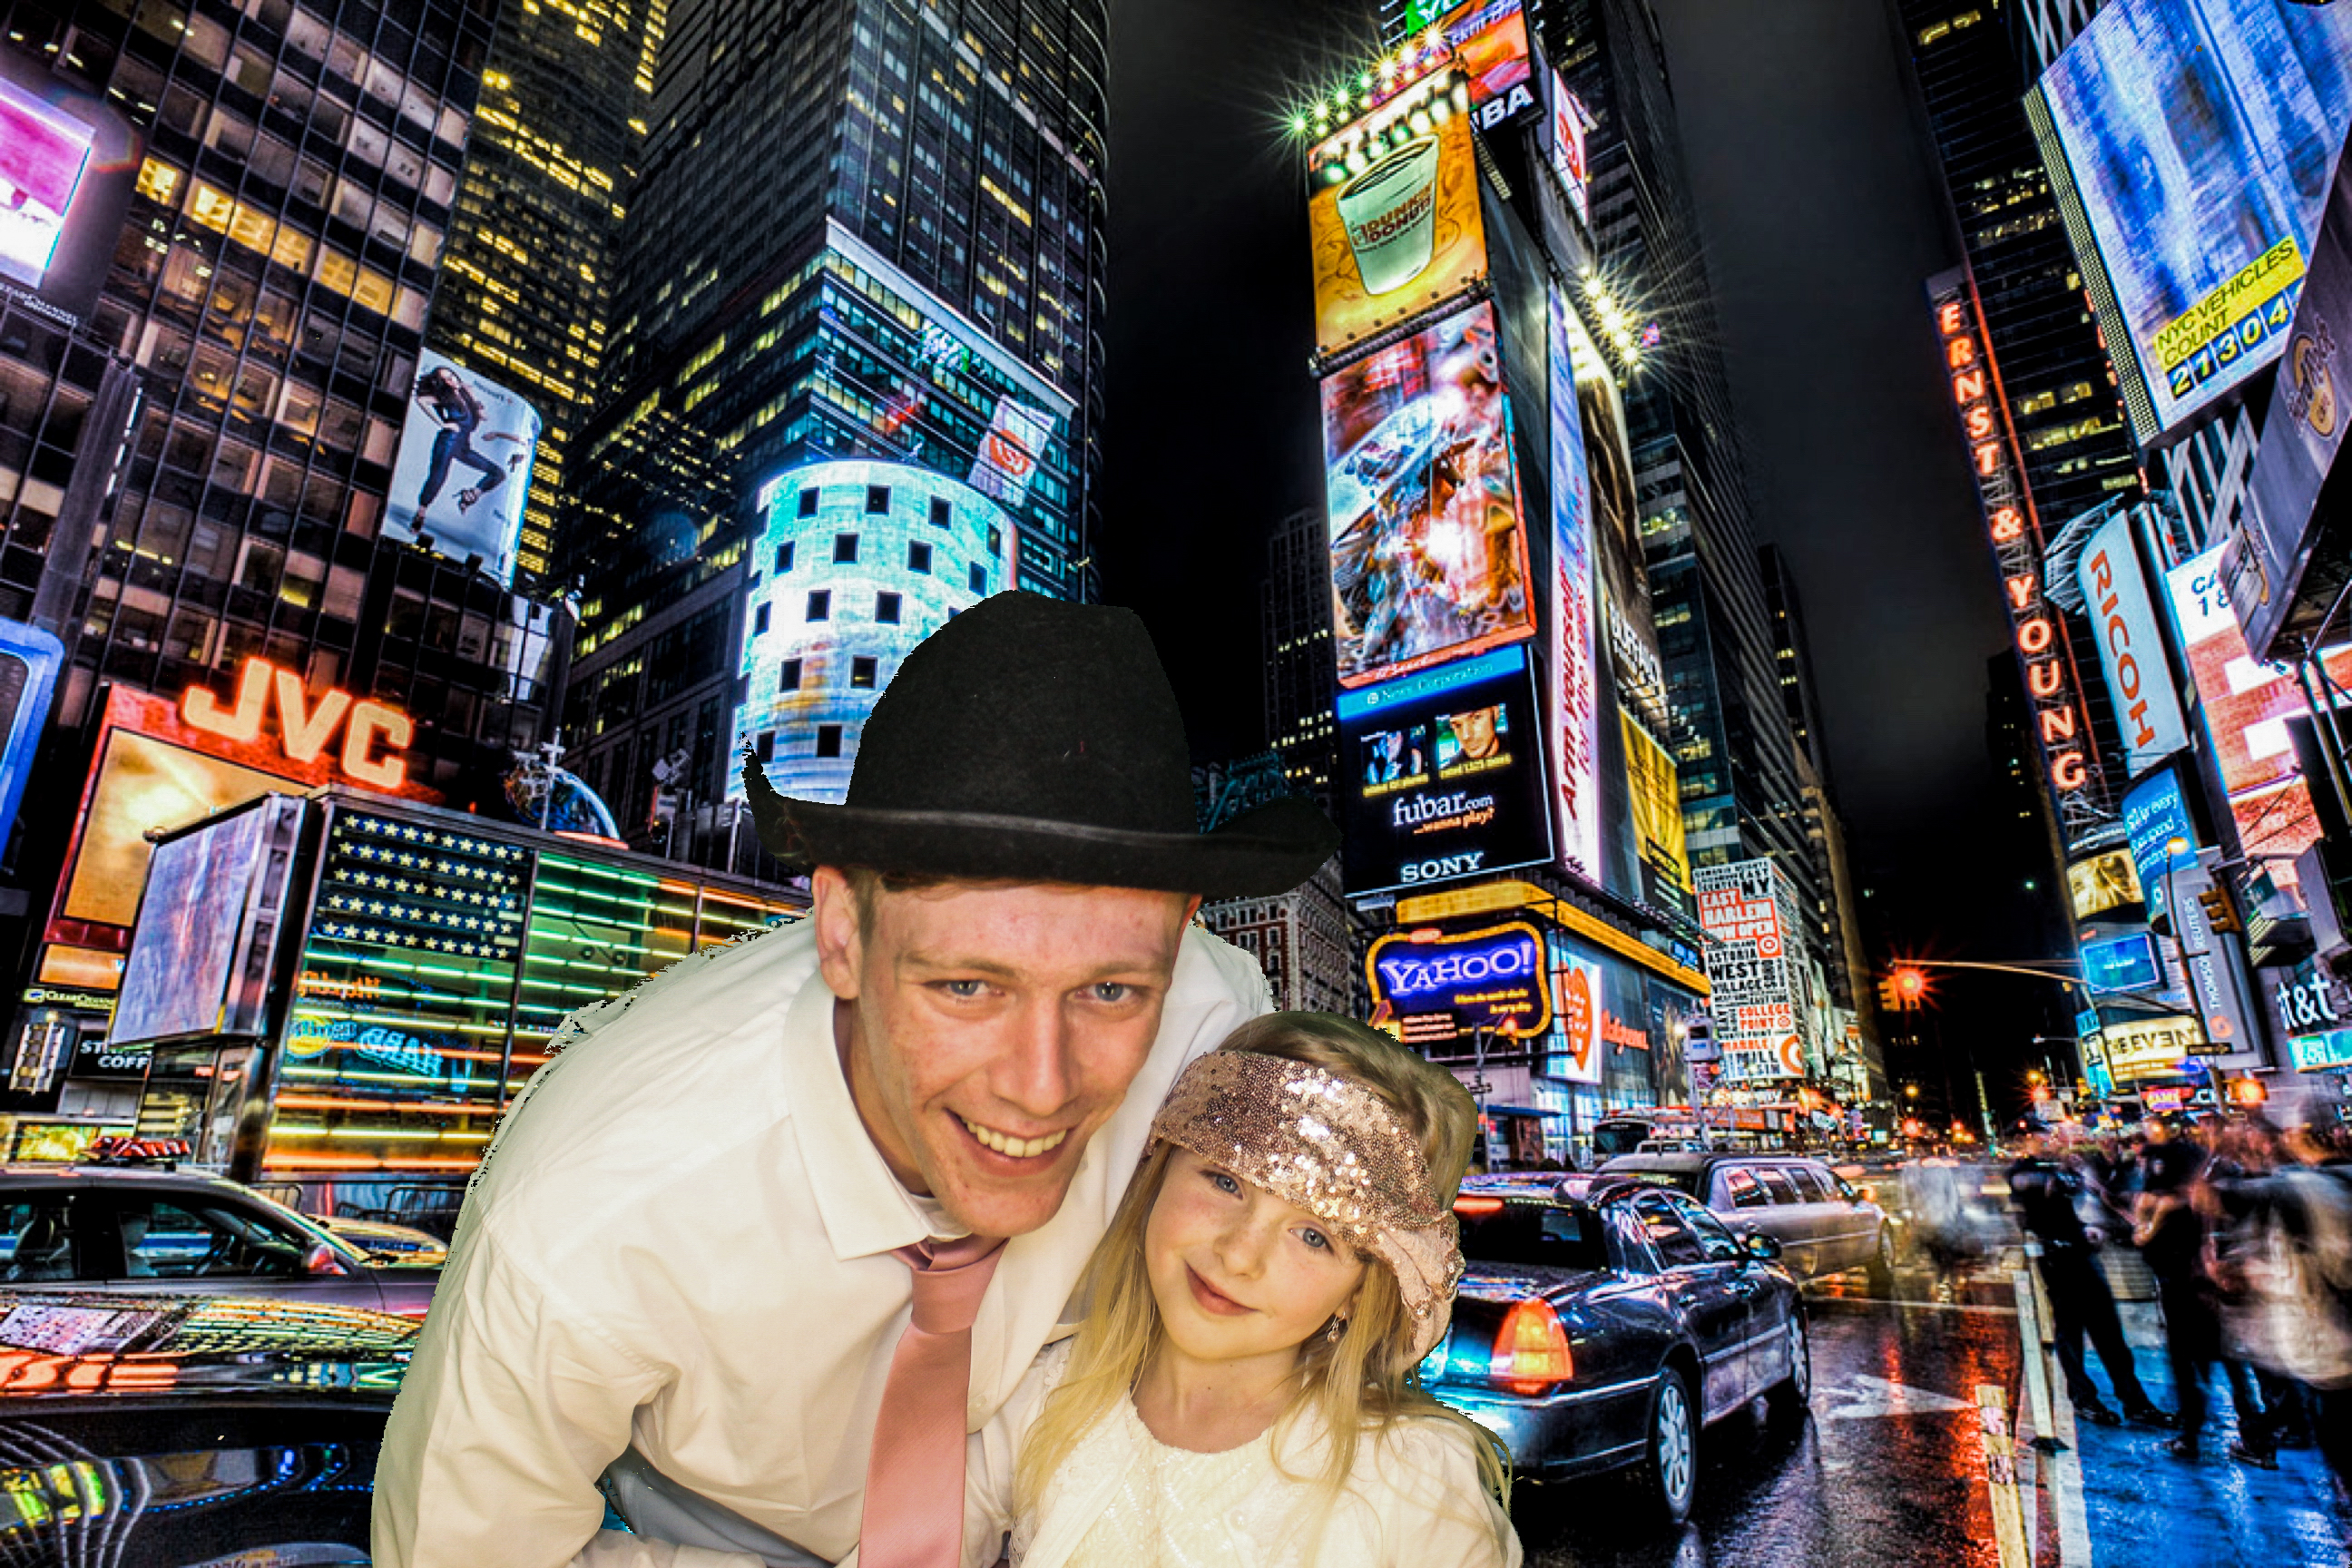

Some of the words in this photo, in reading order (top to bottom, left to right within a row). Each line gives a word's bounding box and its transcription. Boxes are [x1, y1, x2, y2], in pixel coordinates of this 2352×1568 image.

[2159, 311, 2194, 349] NYC
[2197, 239, 2293, 318] VEHICLES
[2164, 307, 2229, 365] COUNT
[1939, 303, 1999, 475] ERNST
[1991, 507, 2022, 541] &
[2007, 575, 2087, 789] YOUNG
[1559, 566, 1577, 717] yourself
[2089, 549, 2155, 749] RICOH
[1417, 662, 1494, 691] Corporation
[182, 657, 413, 789] JVC
[1561, 727, 1577, 820] Arm
[1393, 791, 1494, 827] fubar.com
[1400, 850, 1485, 883] SONY
[1700, 889, 1738, 908] EAST
[1742, 878, 1769, 897] NY
[1703, 901, 1772, 925] HARLEM
[1738, 920, 1775, 936] OPEN
[2182, 897, 2206, 950] REUTERS
[1377, 939, 1535, 995] YAHOO!
[1710, 962, 1759, 981] WEST
[1739, 1002, 1791, 1018] COLLEGE
[1739, 1017, 1775, 1030] POINT
[98, 1054, 149, 1069] COFF
